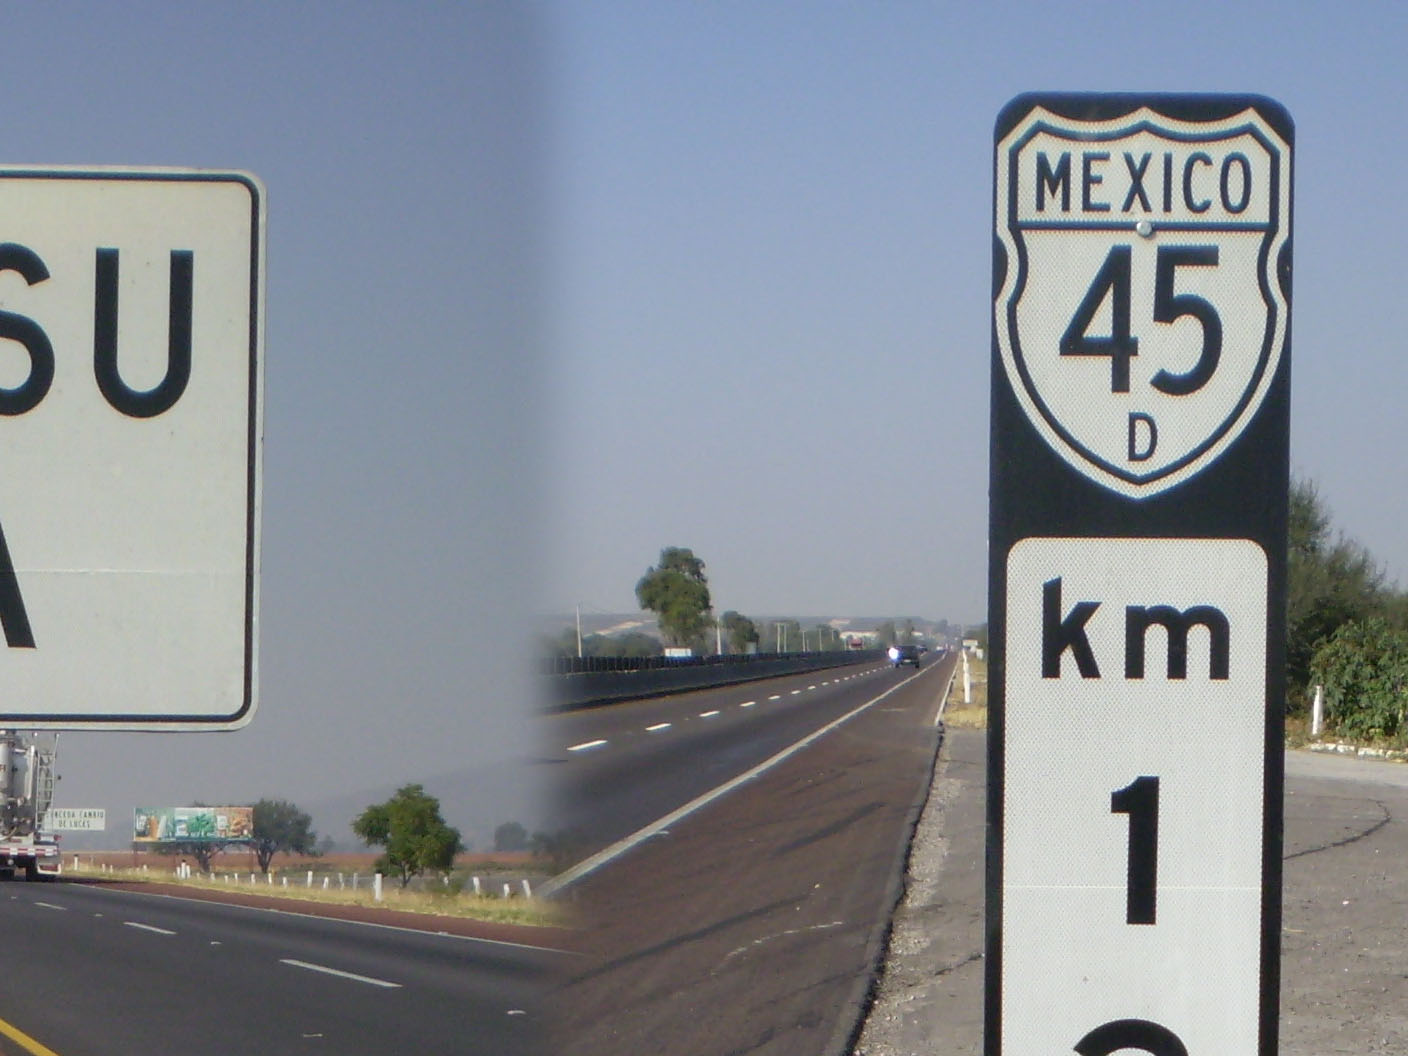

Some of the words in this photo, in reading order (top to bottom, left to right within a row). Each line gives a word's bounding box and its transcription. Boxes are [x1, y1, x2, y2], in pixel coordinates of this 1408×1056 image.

[1035, 151, 1252, 215] MEXICO
[1059, 244, 1223, 397] 45
[1127, 411, 1159, 462] D
[1041, 576, 1231, 681] km
[1109, 775, 1160, 926] 1
